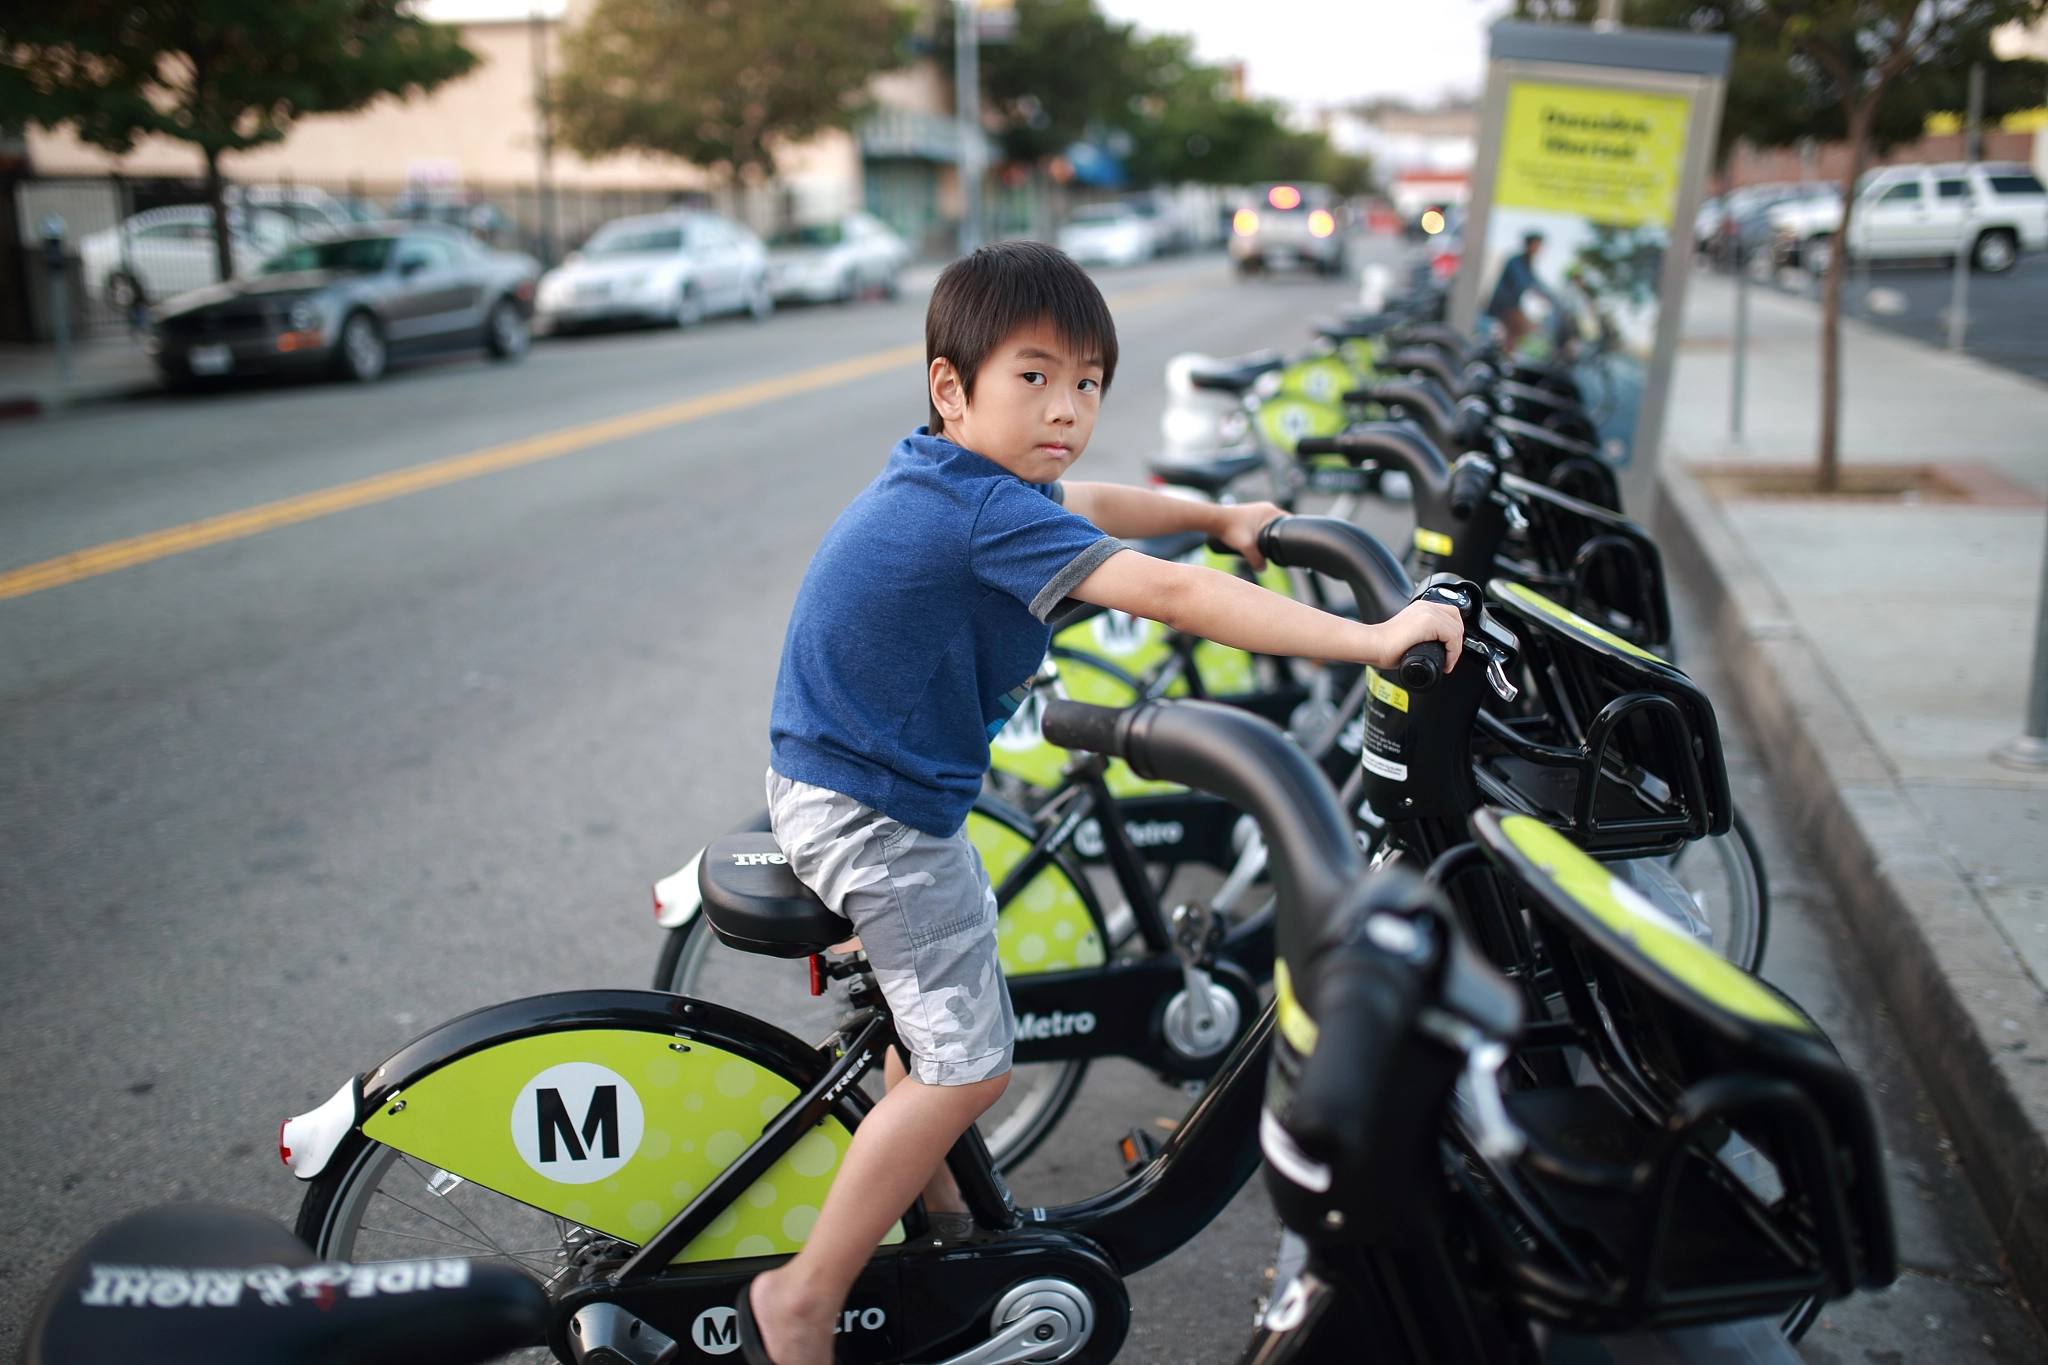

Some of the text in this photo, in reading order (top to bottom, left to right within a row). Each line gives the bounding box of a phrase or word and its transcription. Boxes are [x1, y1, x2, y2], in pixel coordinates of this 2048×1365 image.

[1013, 1010, 1096, 1041] Metro
[821, 1048, 873, 1101] TREK
[536, 1085, 620, 1163] M
[80, 1259, 471, 1307] RIDE RIGHT
[703, 1315, 737, 1346] M
